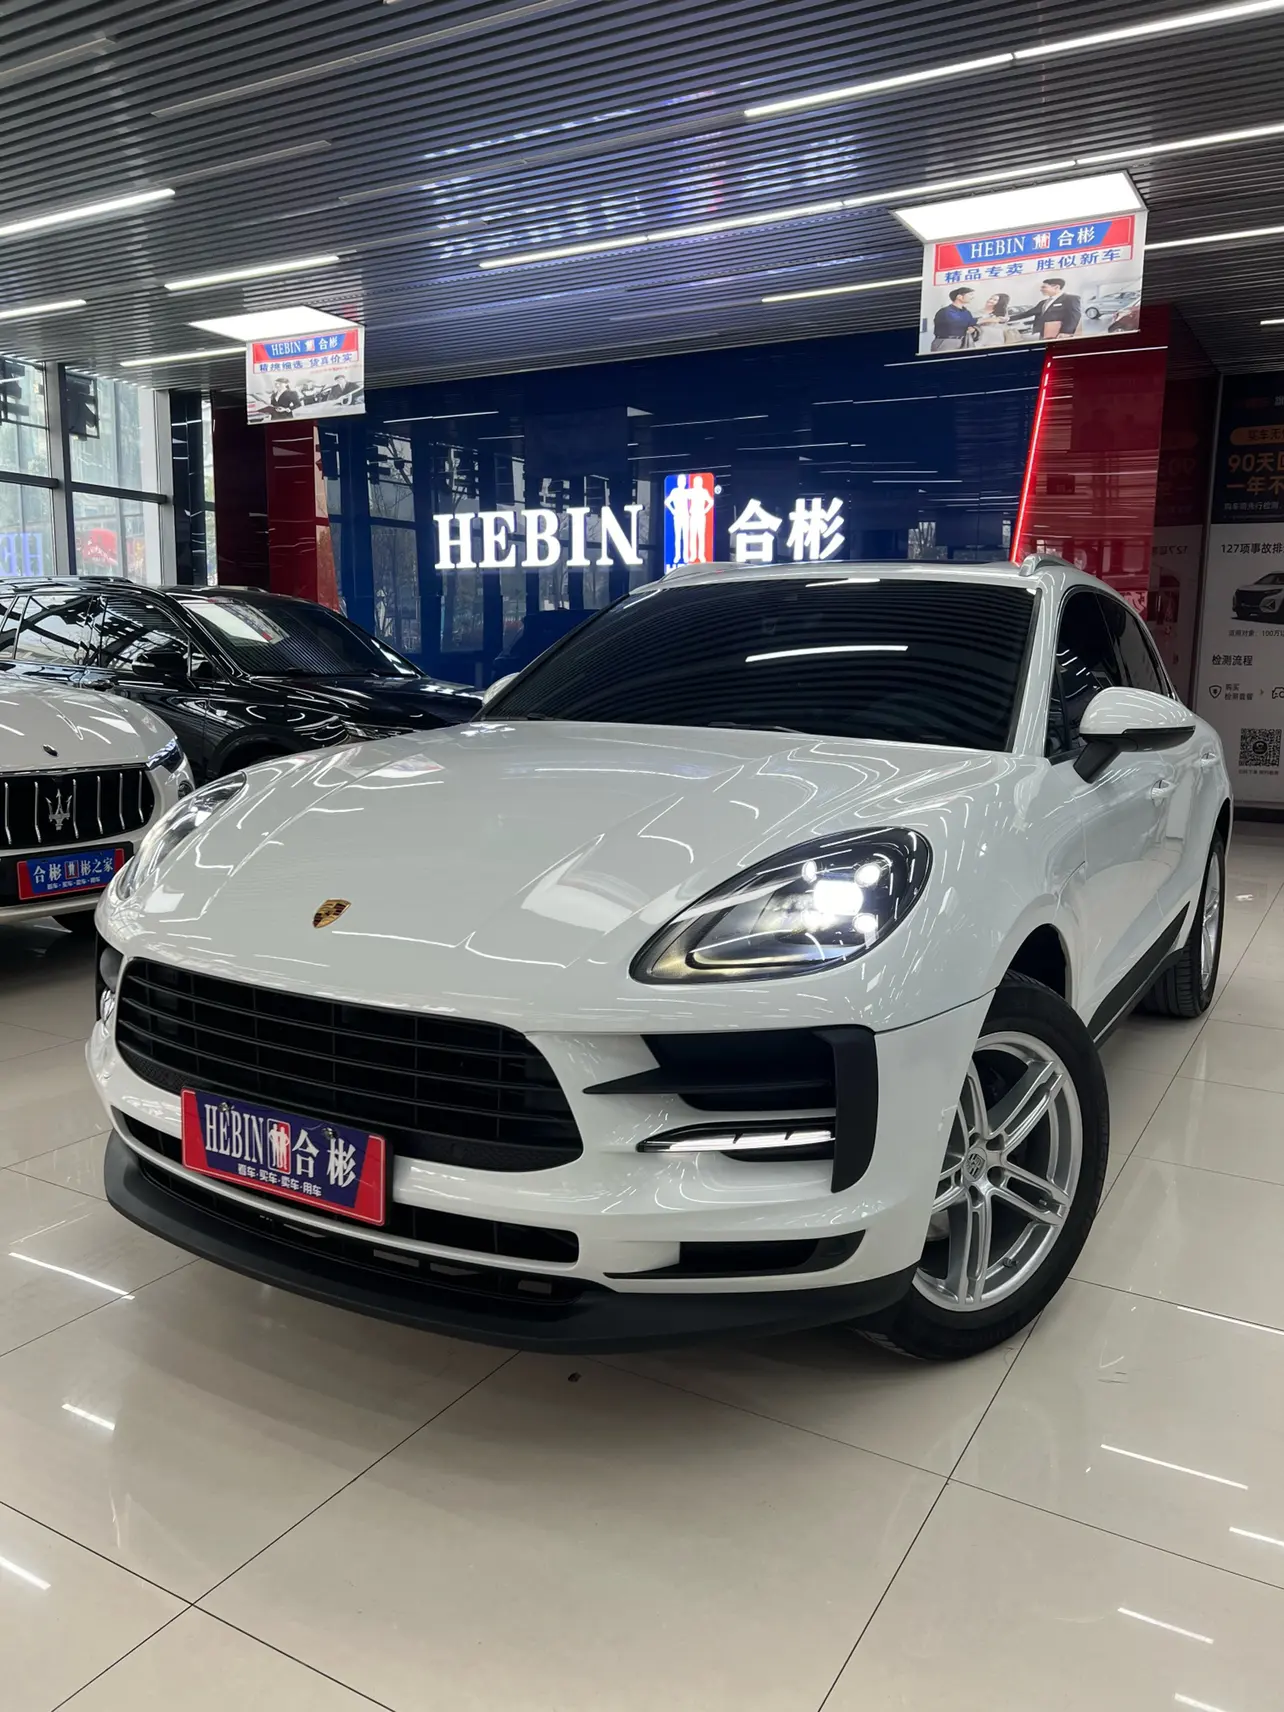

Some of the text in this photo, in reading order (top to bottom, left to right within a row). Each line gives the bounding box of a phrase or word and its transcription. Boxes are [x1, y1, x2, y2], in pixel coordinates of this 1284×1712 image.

[970, 226, 1096, 260] HEBIN 合彬
[944, 248, 1121, 284] 精品专卖 胜似新车
[271, 340, 301, 356] HEBIN
[433, 497, 846, 569] HEBIN 合彬
[1220, 542, 1284, 555] 127项事故排
[1211, 654, 1253, 667] 检测流程
[33, 857, 114, 884] 合彬 彬之家
[203, 1103, 357, 1188] HEBIN 合彬
